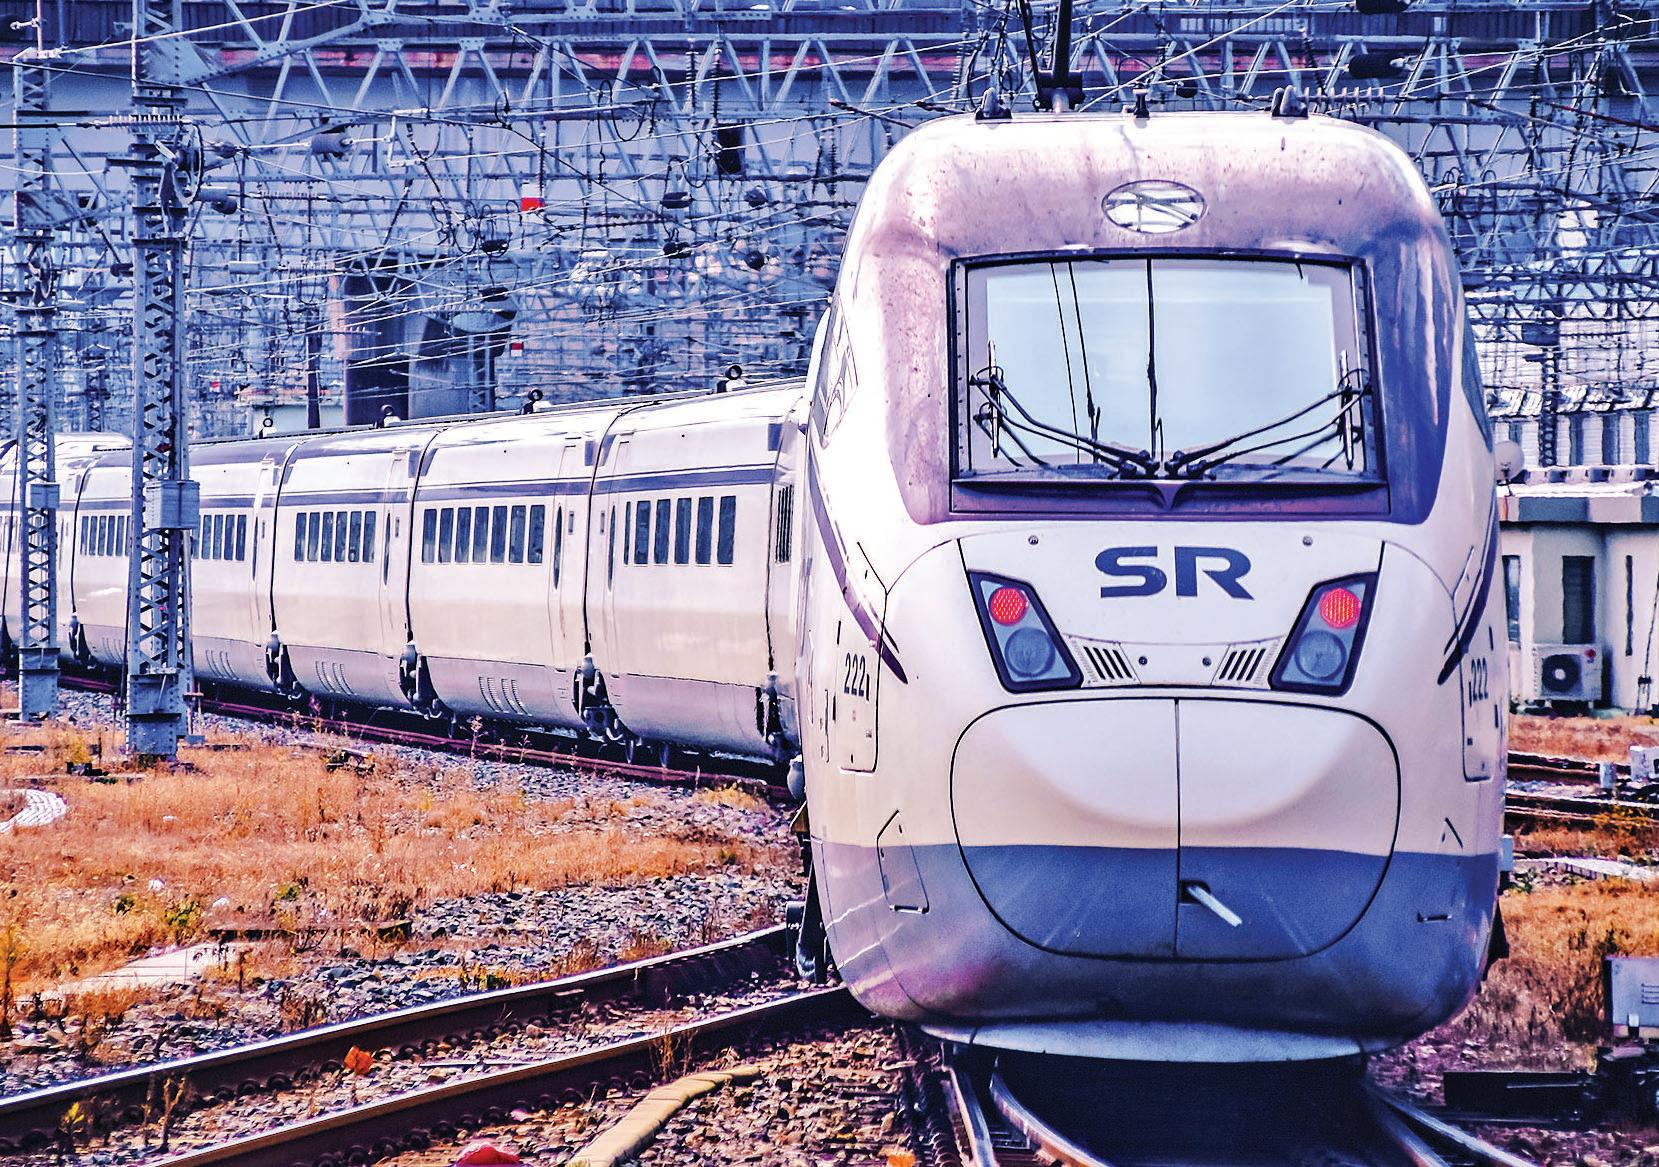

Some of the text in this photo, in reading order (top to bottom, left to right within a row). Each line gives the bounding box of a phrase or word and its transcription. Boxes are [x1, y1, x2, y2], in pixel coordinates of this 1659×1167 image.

[1095, 546, 1255, 600] SR
[844, 652, 866, 697] 222
[1471, 657, 1488, 701] 222
